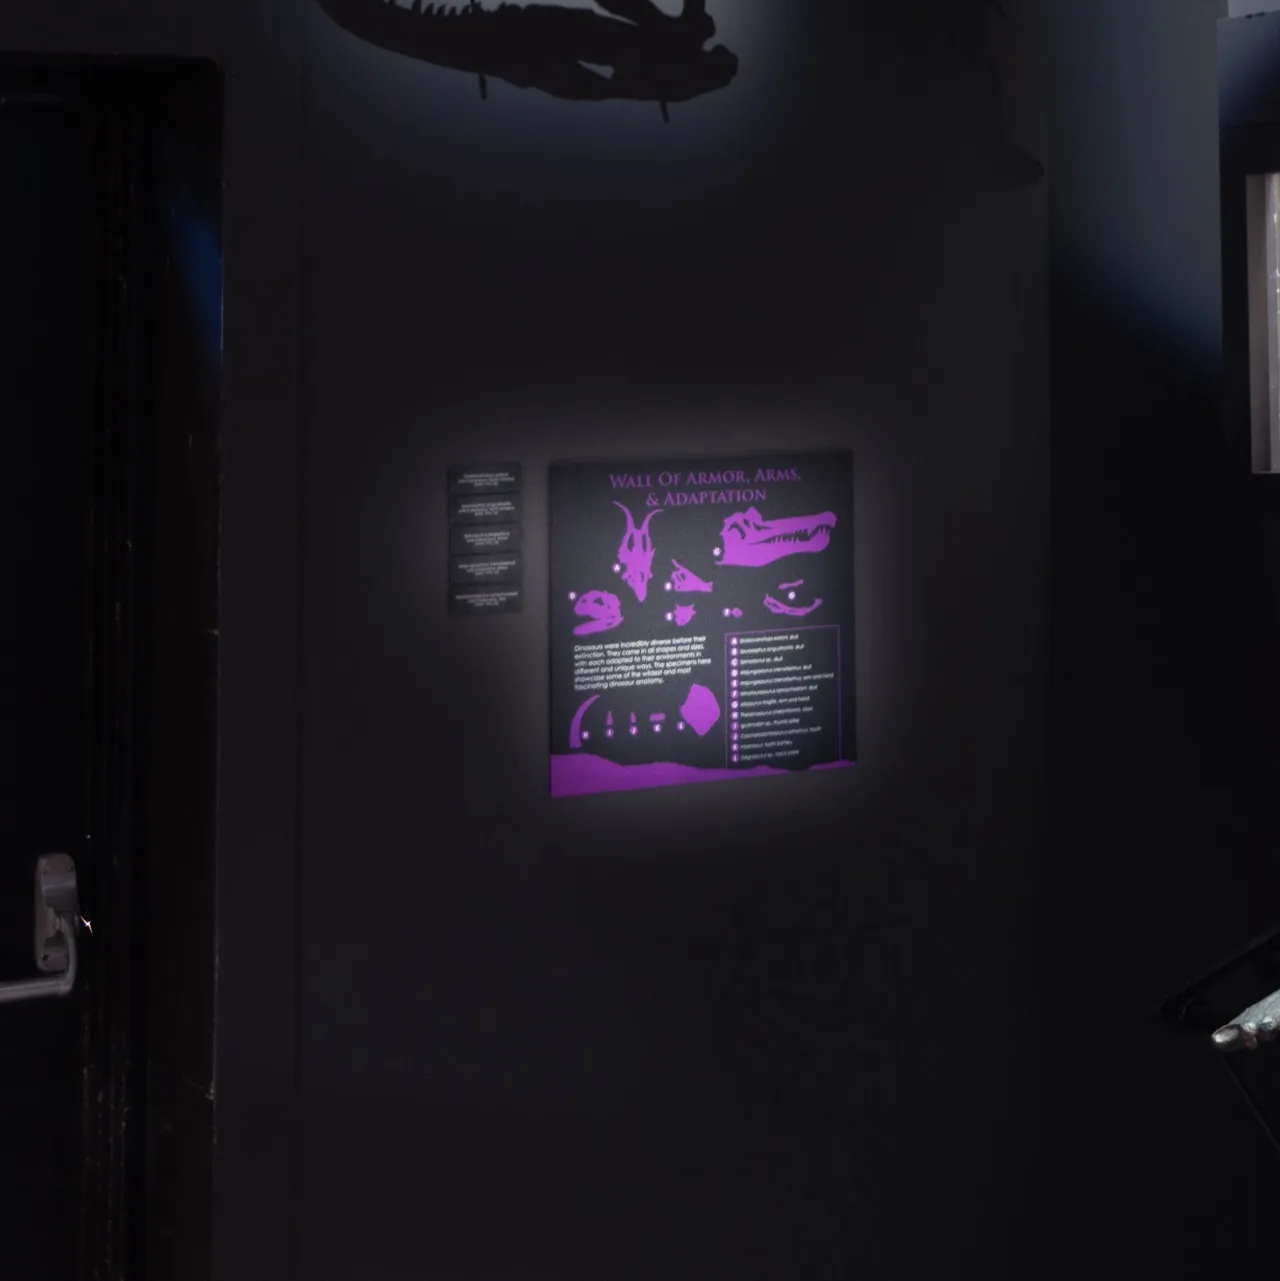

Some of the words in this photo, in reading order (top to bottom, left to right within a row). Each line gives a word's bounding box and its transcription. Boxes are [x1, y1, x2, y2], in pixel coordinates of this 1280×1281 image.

[609, 473, 652, 489] WALL
[659, 472, 681, 487] OF
[646, 493, 659, 506] &
[664, 488, 766, 506] ADAPTATION
